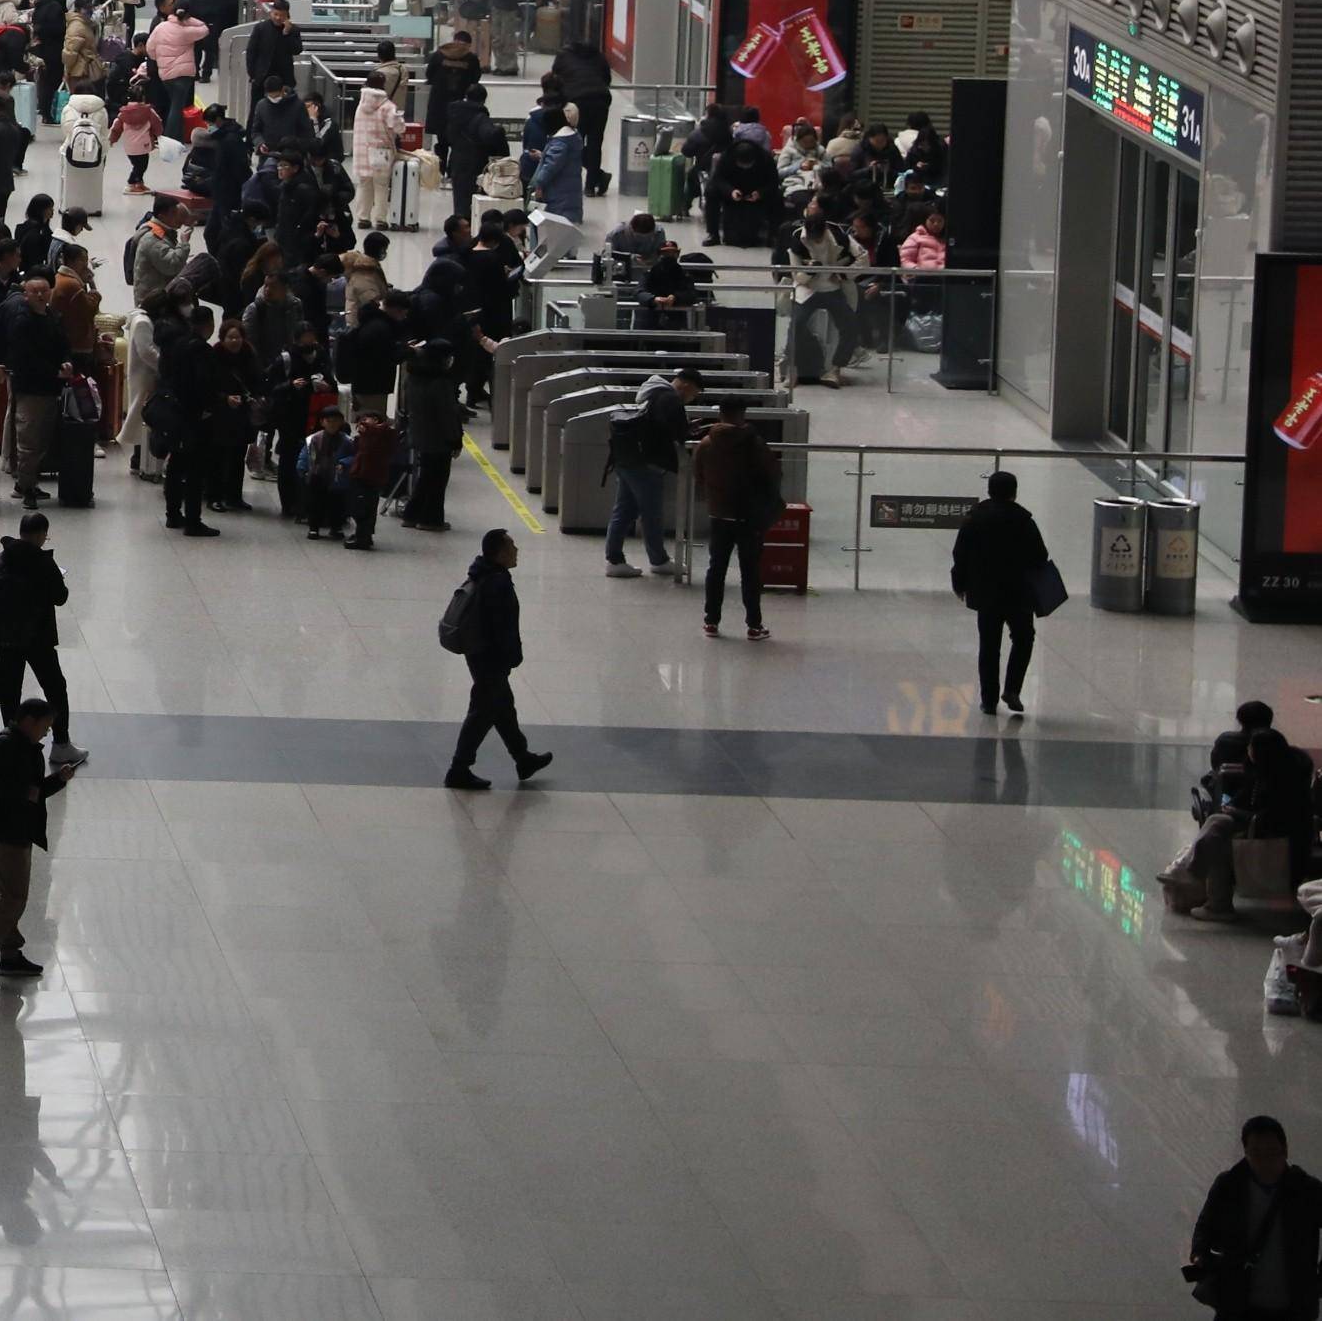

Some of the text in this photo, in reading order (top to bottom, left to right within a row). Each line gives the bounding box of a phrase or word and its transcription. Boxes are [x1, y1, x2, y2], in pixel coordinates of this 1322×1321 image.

[798, 25, 828, 75] 王老吉
[1072, 45, 1091, 84] 30A
[1180, 105, 1201, 146] 31A
[1284, 387, 1316, 428] 王老吉
[1262, 576, 1301, 588] ZZ 30
